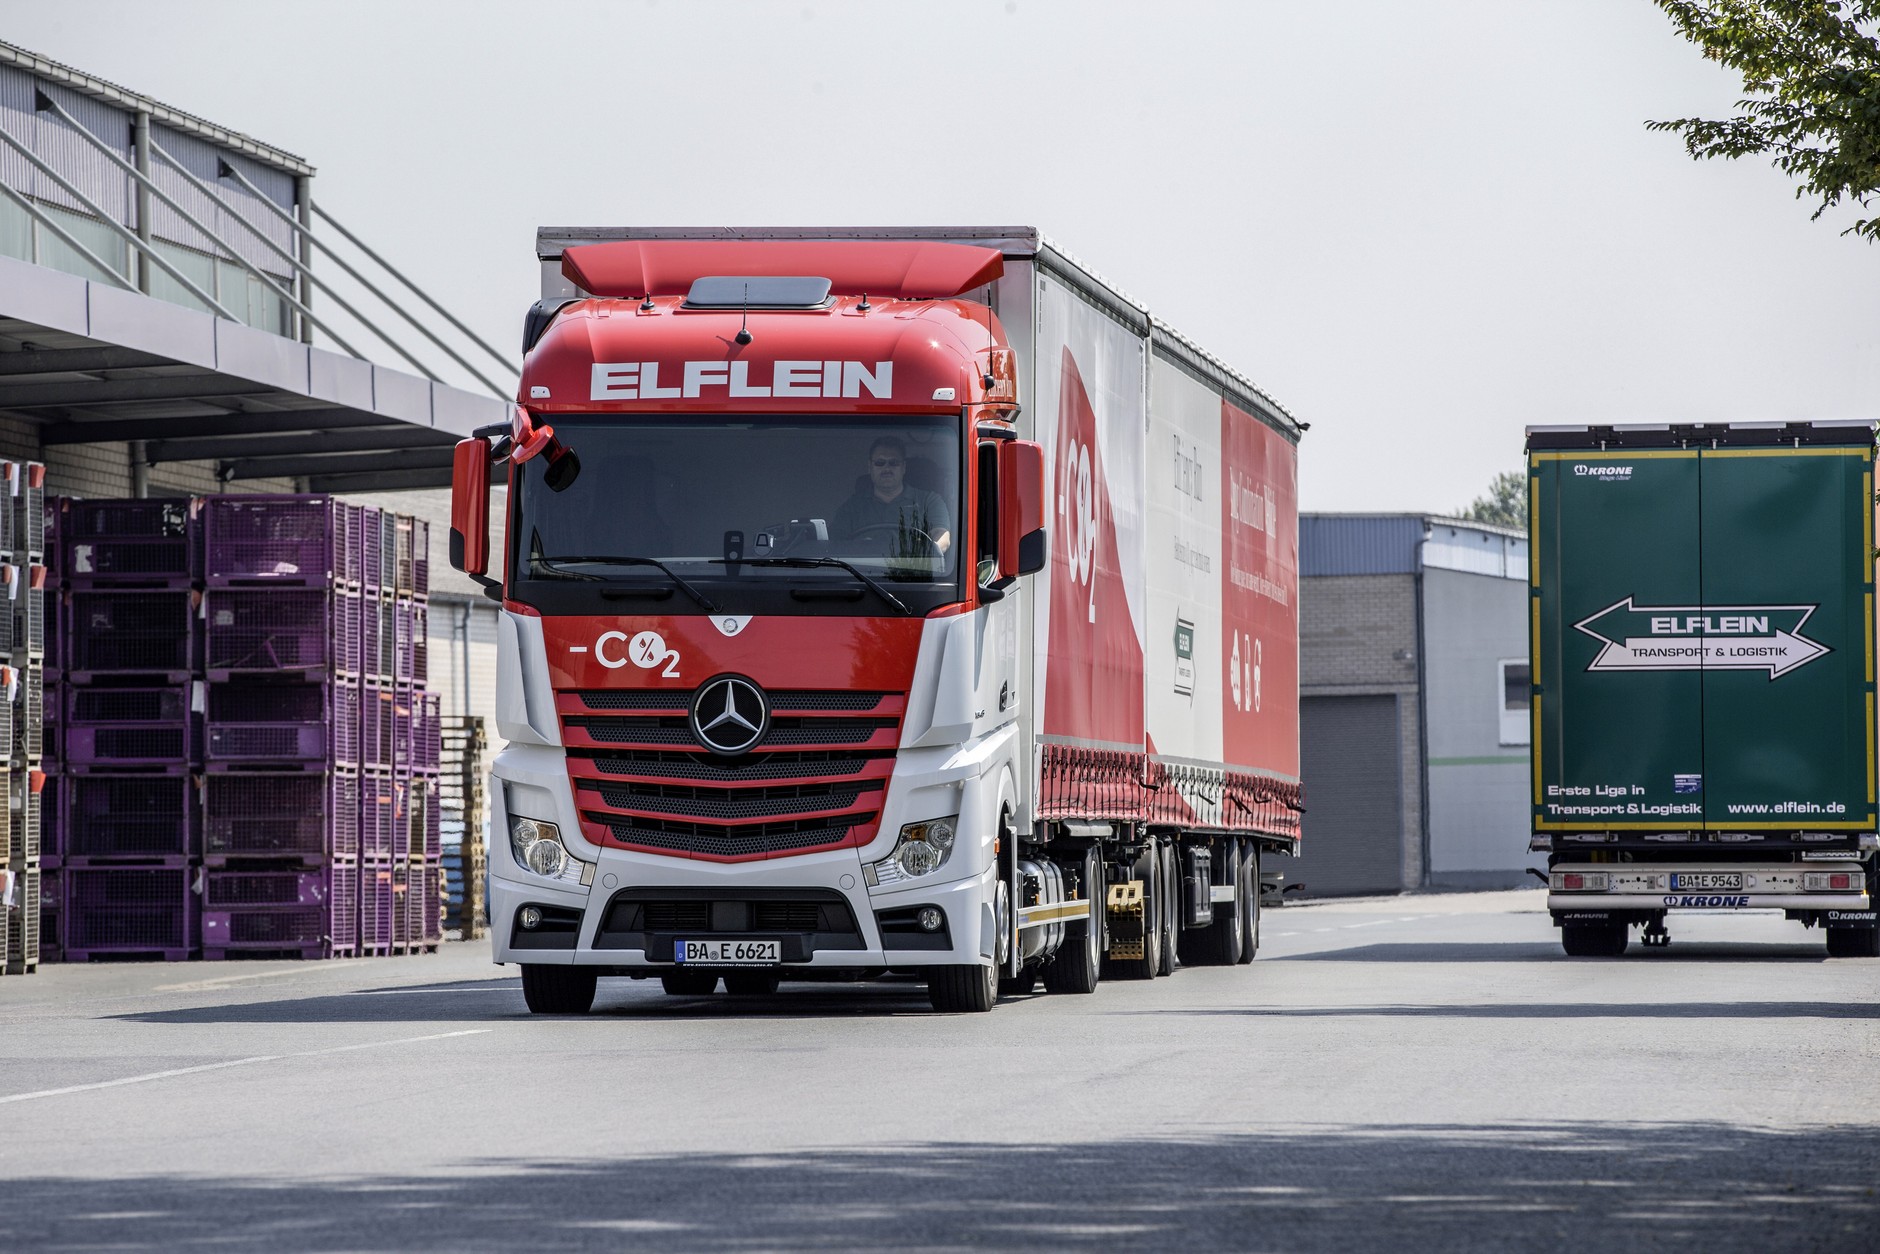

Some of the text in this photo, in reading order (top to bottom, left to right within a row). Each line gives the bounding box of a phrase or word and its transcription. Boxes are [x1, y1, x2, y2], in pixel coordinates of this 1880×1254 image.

[590, 360, 894, 401] ELFLEIN
[1588, 466, 1633, 475] KRONE
[1651, 616, 1768, 634] ELFLEIN
[1631, 647, 1788, 657] TRANSPORT & LOGISTIK
[1547, 784, 1645, 797] Erste Liga in
[1548, 803, 1703, 816] Transport & Logistik
[1727, 801, 1846, 814] www.elflein.de
[1679, 875, 1740, 887] BA E 9543
[1680, 896, 1750, 907] KRONE
[1840, 912, 1877, 920] KRONE
[687, 943, 709, 960] BA
[720, 943, 732, 960] E
[735, 943, 777, 960] 6621
